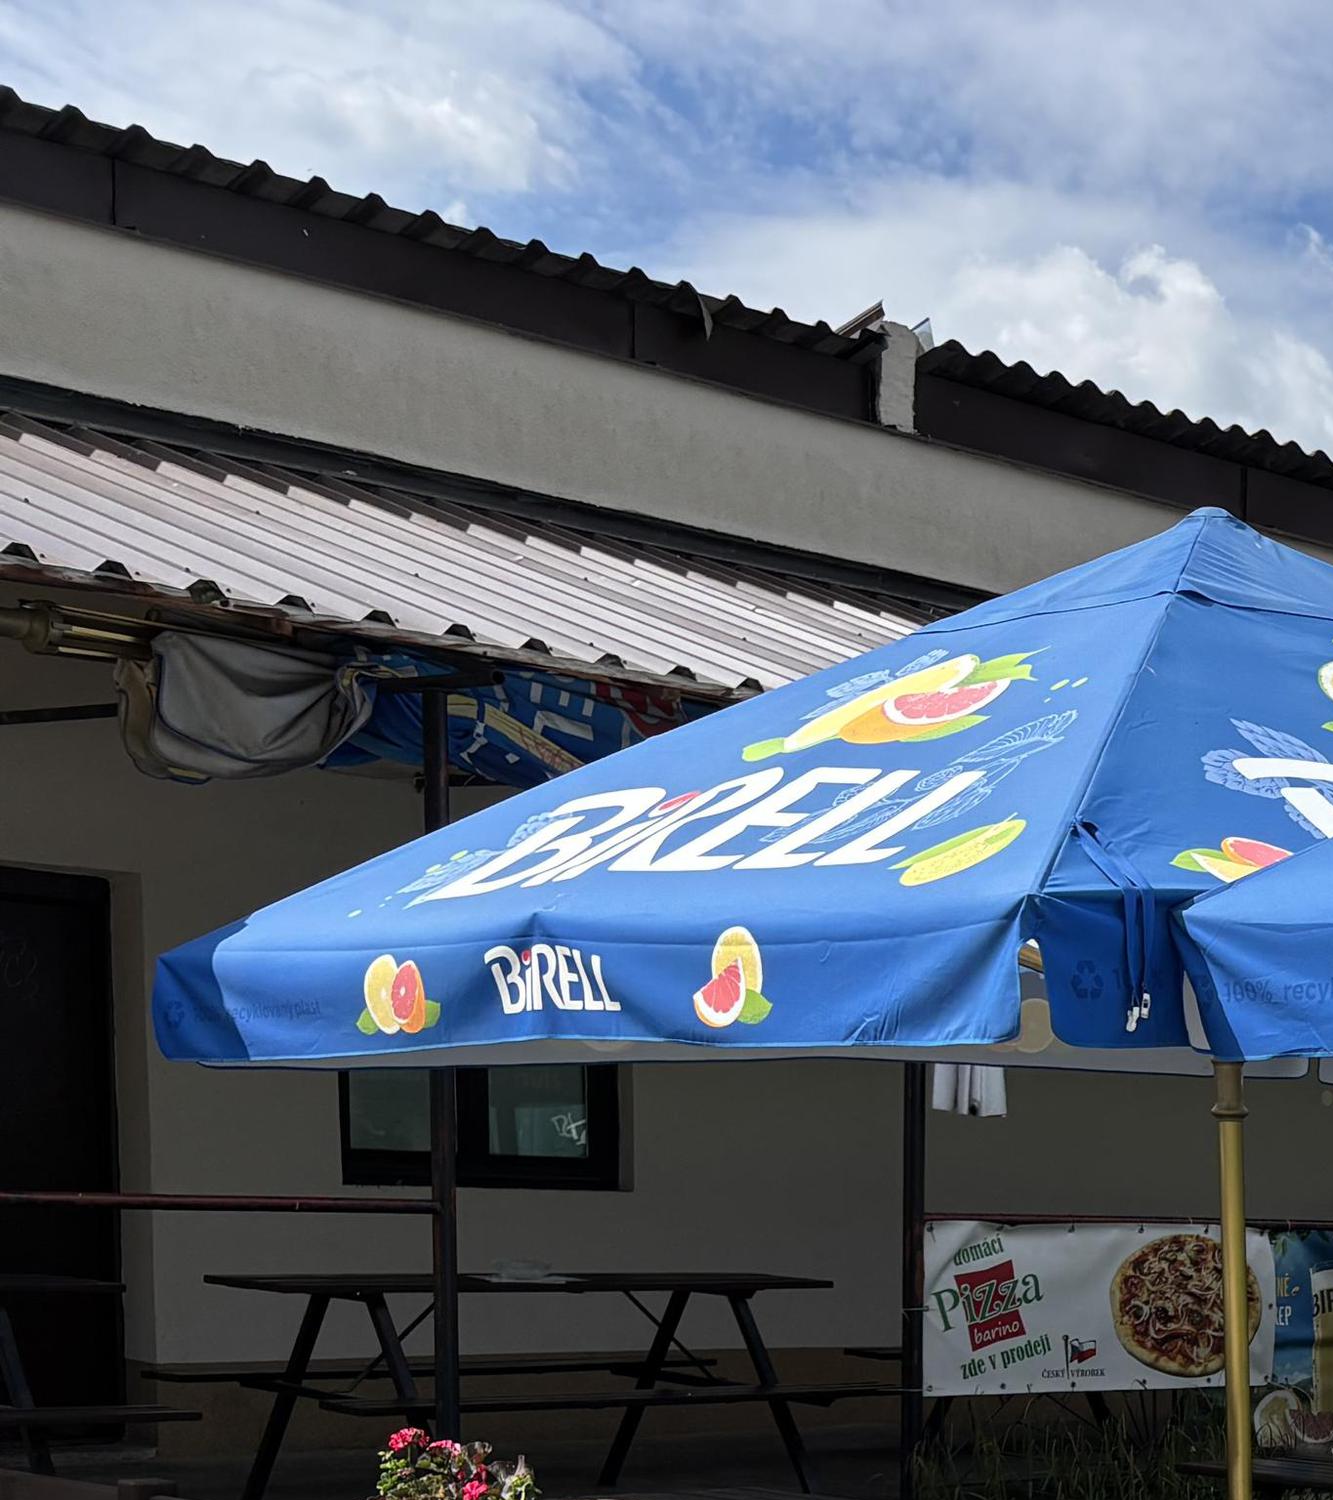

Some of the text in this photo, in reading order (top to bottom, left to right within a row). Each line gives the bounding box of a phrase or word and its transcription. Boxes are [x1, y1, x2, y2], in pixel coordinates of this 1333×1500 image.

[1223, 977, 1272, 1003] 100%
[953, 1233, 1004, 1266] domácí
[930, 1272, 1044, 1333] Pizza
[973, 1320, 1020, 1344] barino
[960, 1334, 1052, 1379] zde v prodeji
